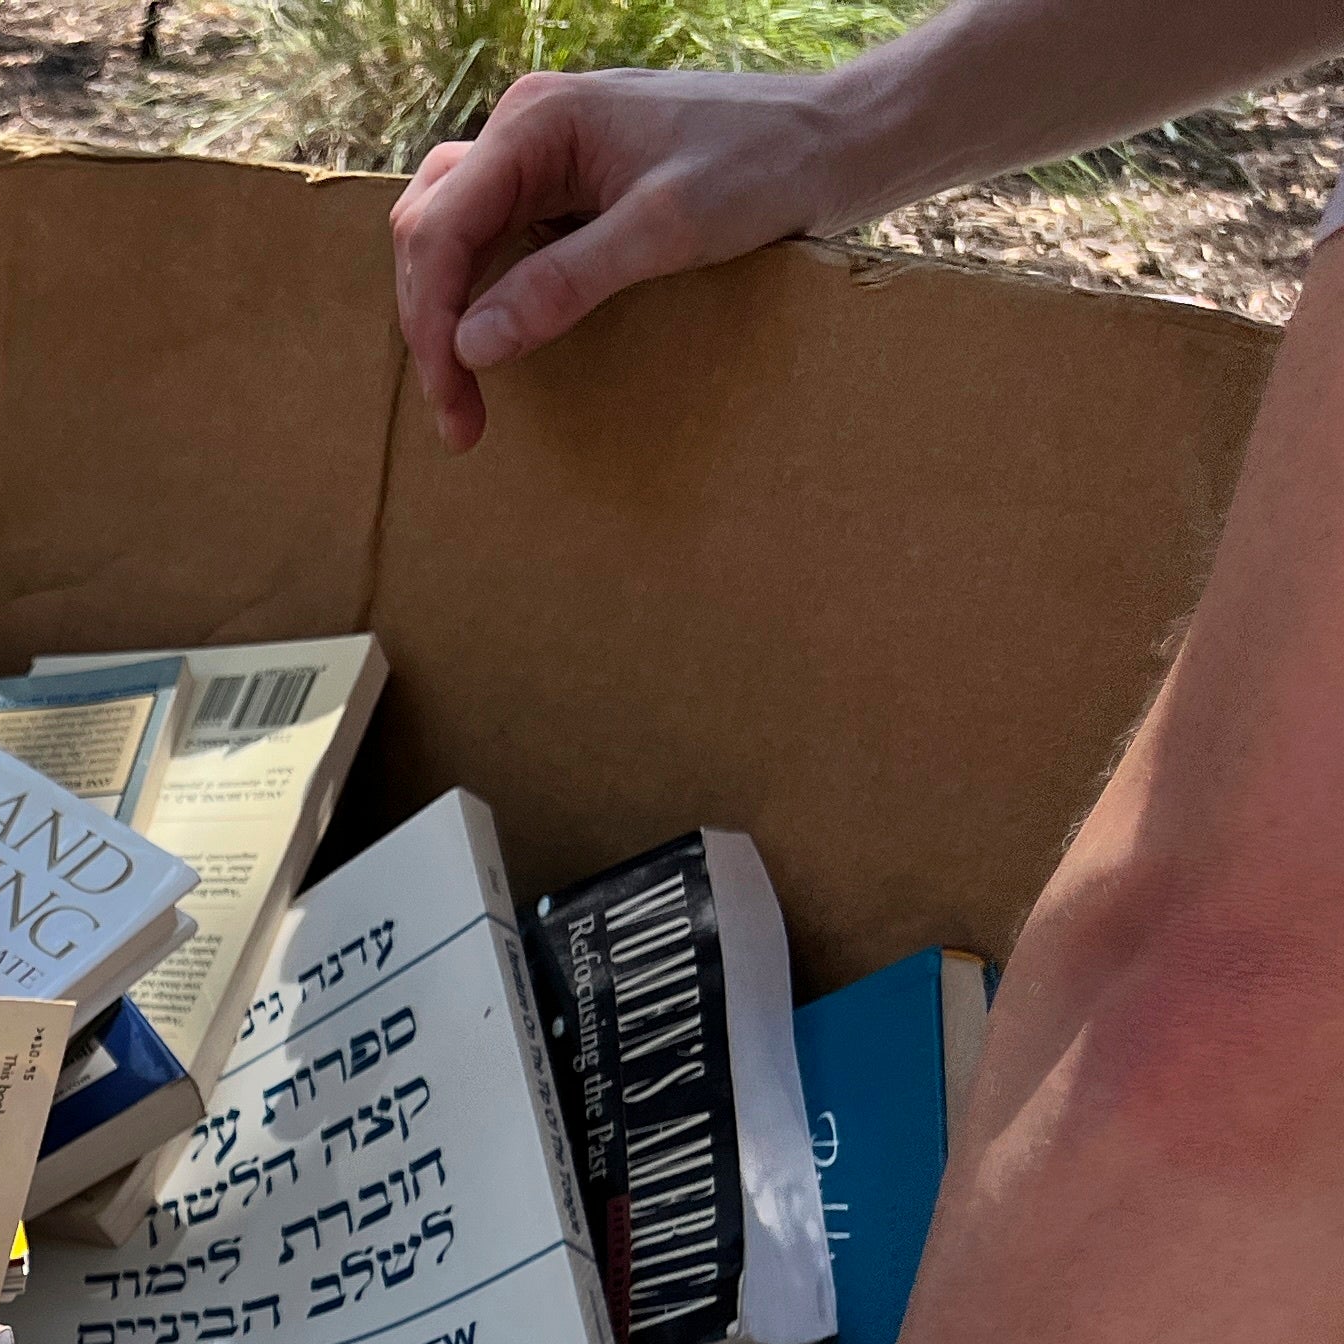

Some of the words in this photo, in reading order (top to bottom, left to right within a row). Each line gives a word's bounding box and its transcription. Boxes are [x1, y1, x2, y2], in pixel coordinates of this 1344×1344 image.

[296, 917, 393, 1003] עדנה
[566, 911, 606, 1073] Refocusing
[602, 871, 706, 1107] WOMEN'S
[262, 1004, 418, 1126] ספרות
[583, 1069, 610, 1122] the
[320, 1072, 432, 1168] קצה
[587, 1121, 613, 1183] Past
[146, 1145, 295, 1248] הלשון
[279, 1147, 447, 1265] חוברת
[623, 1108, 718, 1336] AMERICA
[78, 1230, 242, 1323] לימוד
[306, 1205, 458, 1320] לשלב
